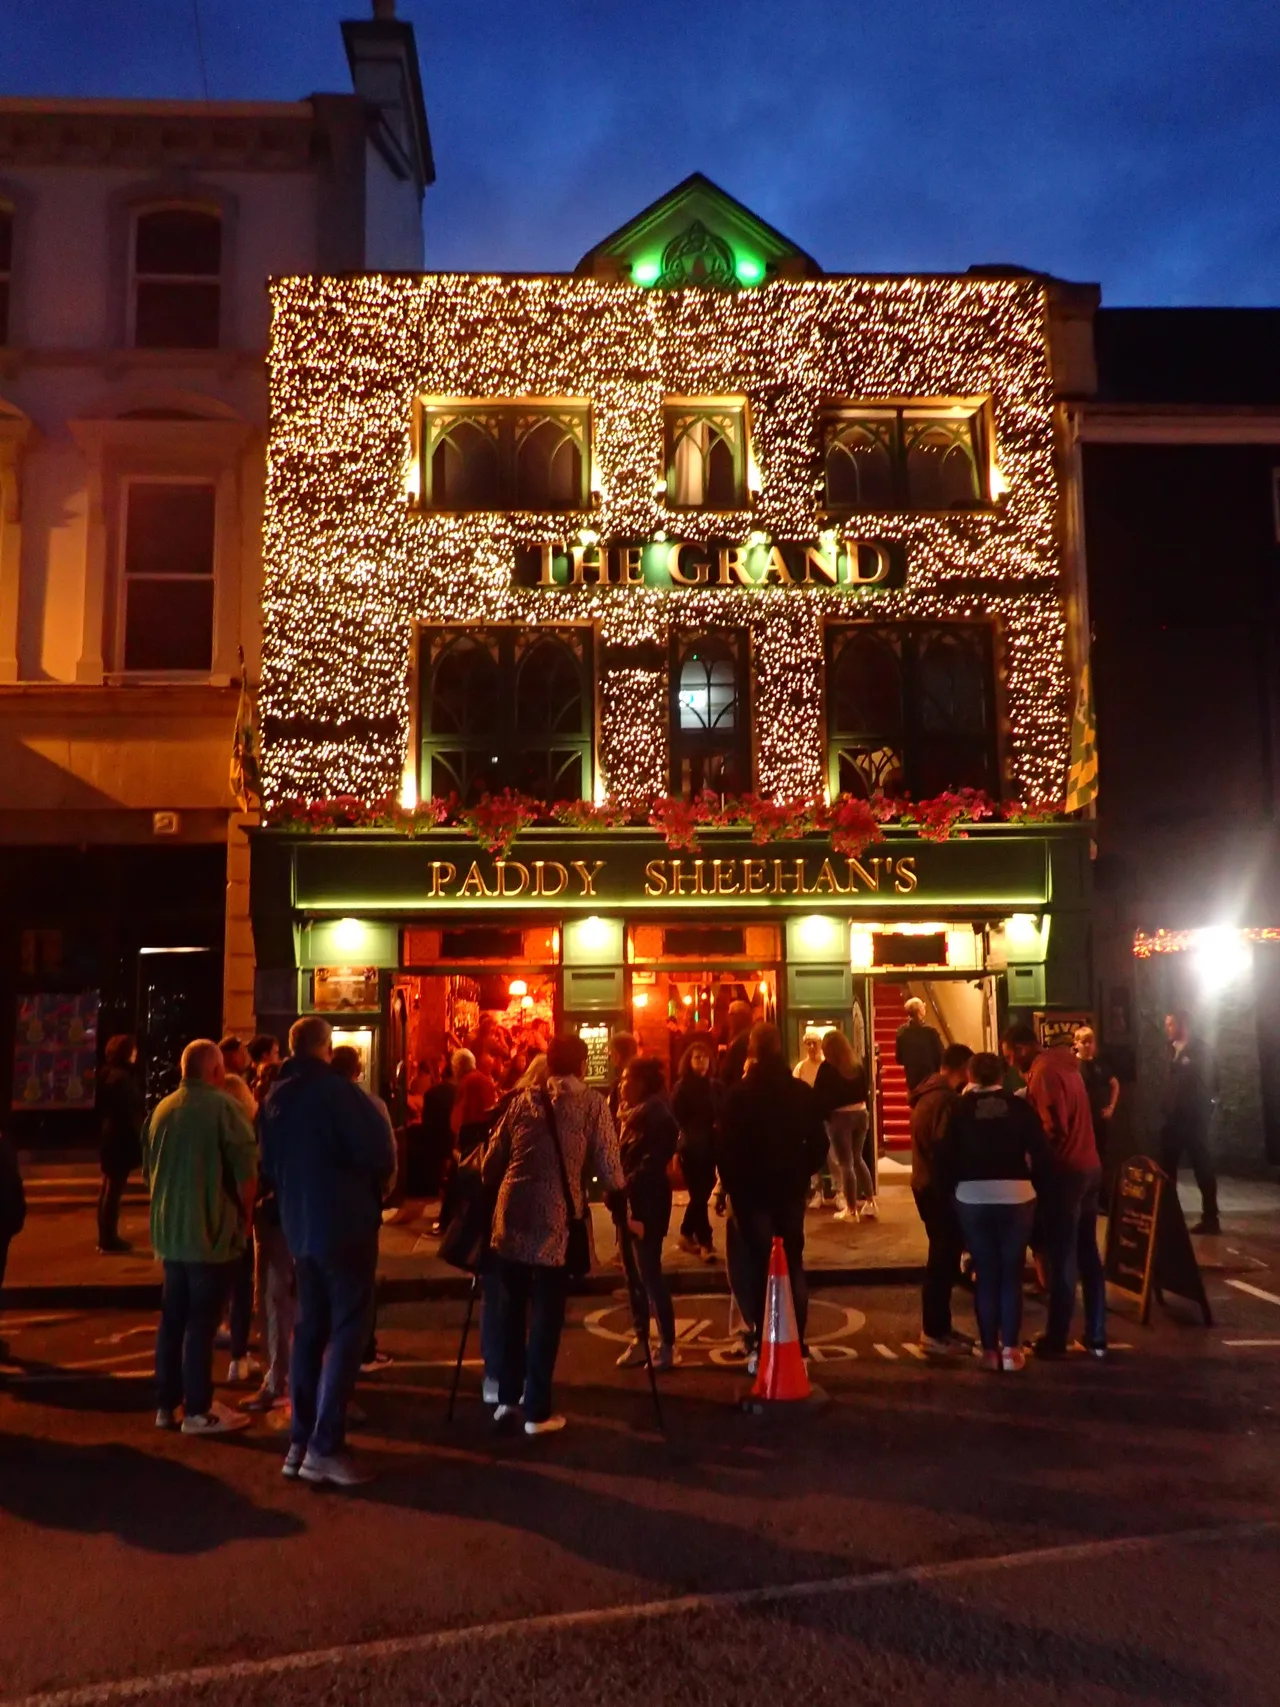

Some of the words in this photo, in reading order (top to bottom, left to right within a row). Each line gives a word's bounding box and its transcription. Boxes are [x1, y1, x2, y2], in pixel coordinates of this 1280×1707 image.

[527, 542, 645, 586] THE
[667, 541, 892, 586] GRAND
[427, 859, 608, 897] PADDY
[643, 857, 919, 896] SHEEHAN'S
